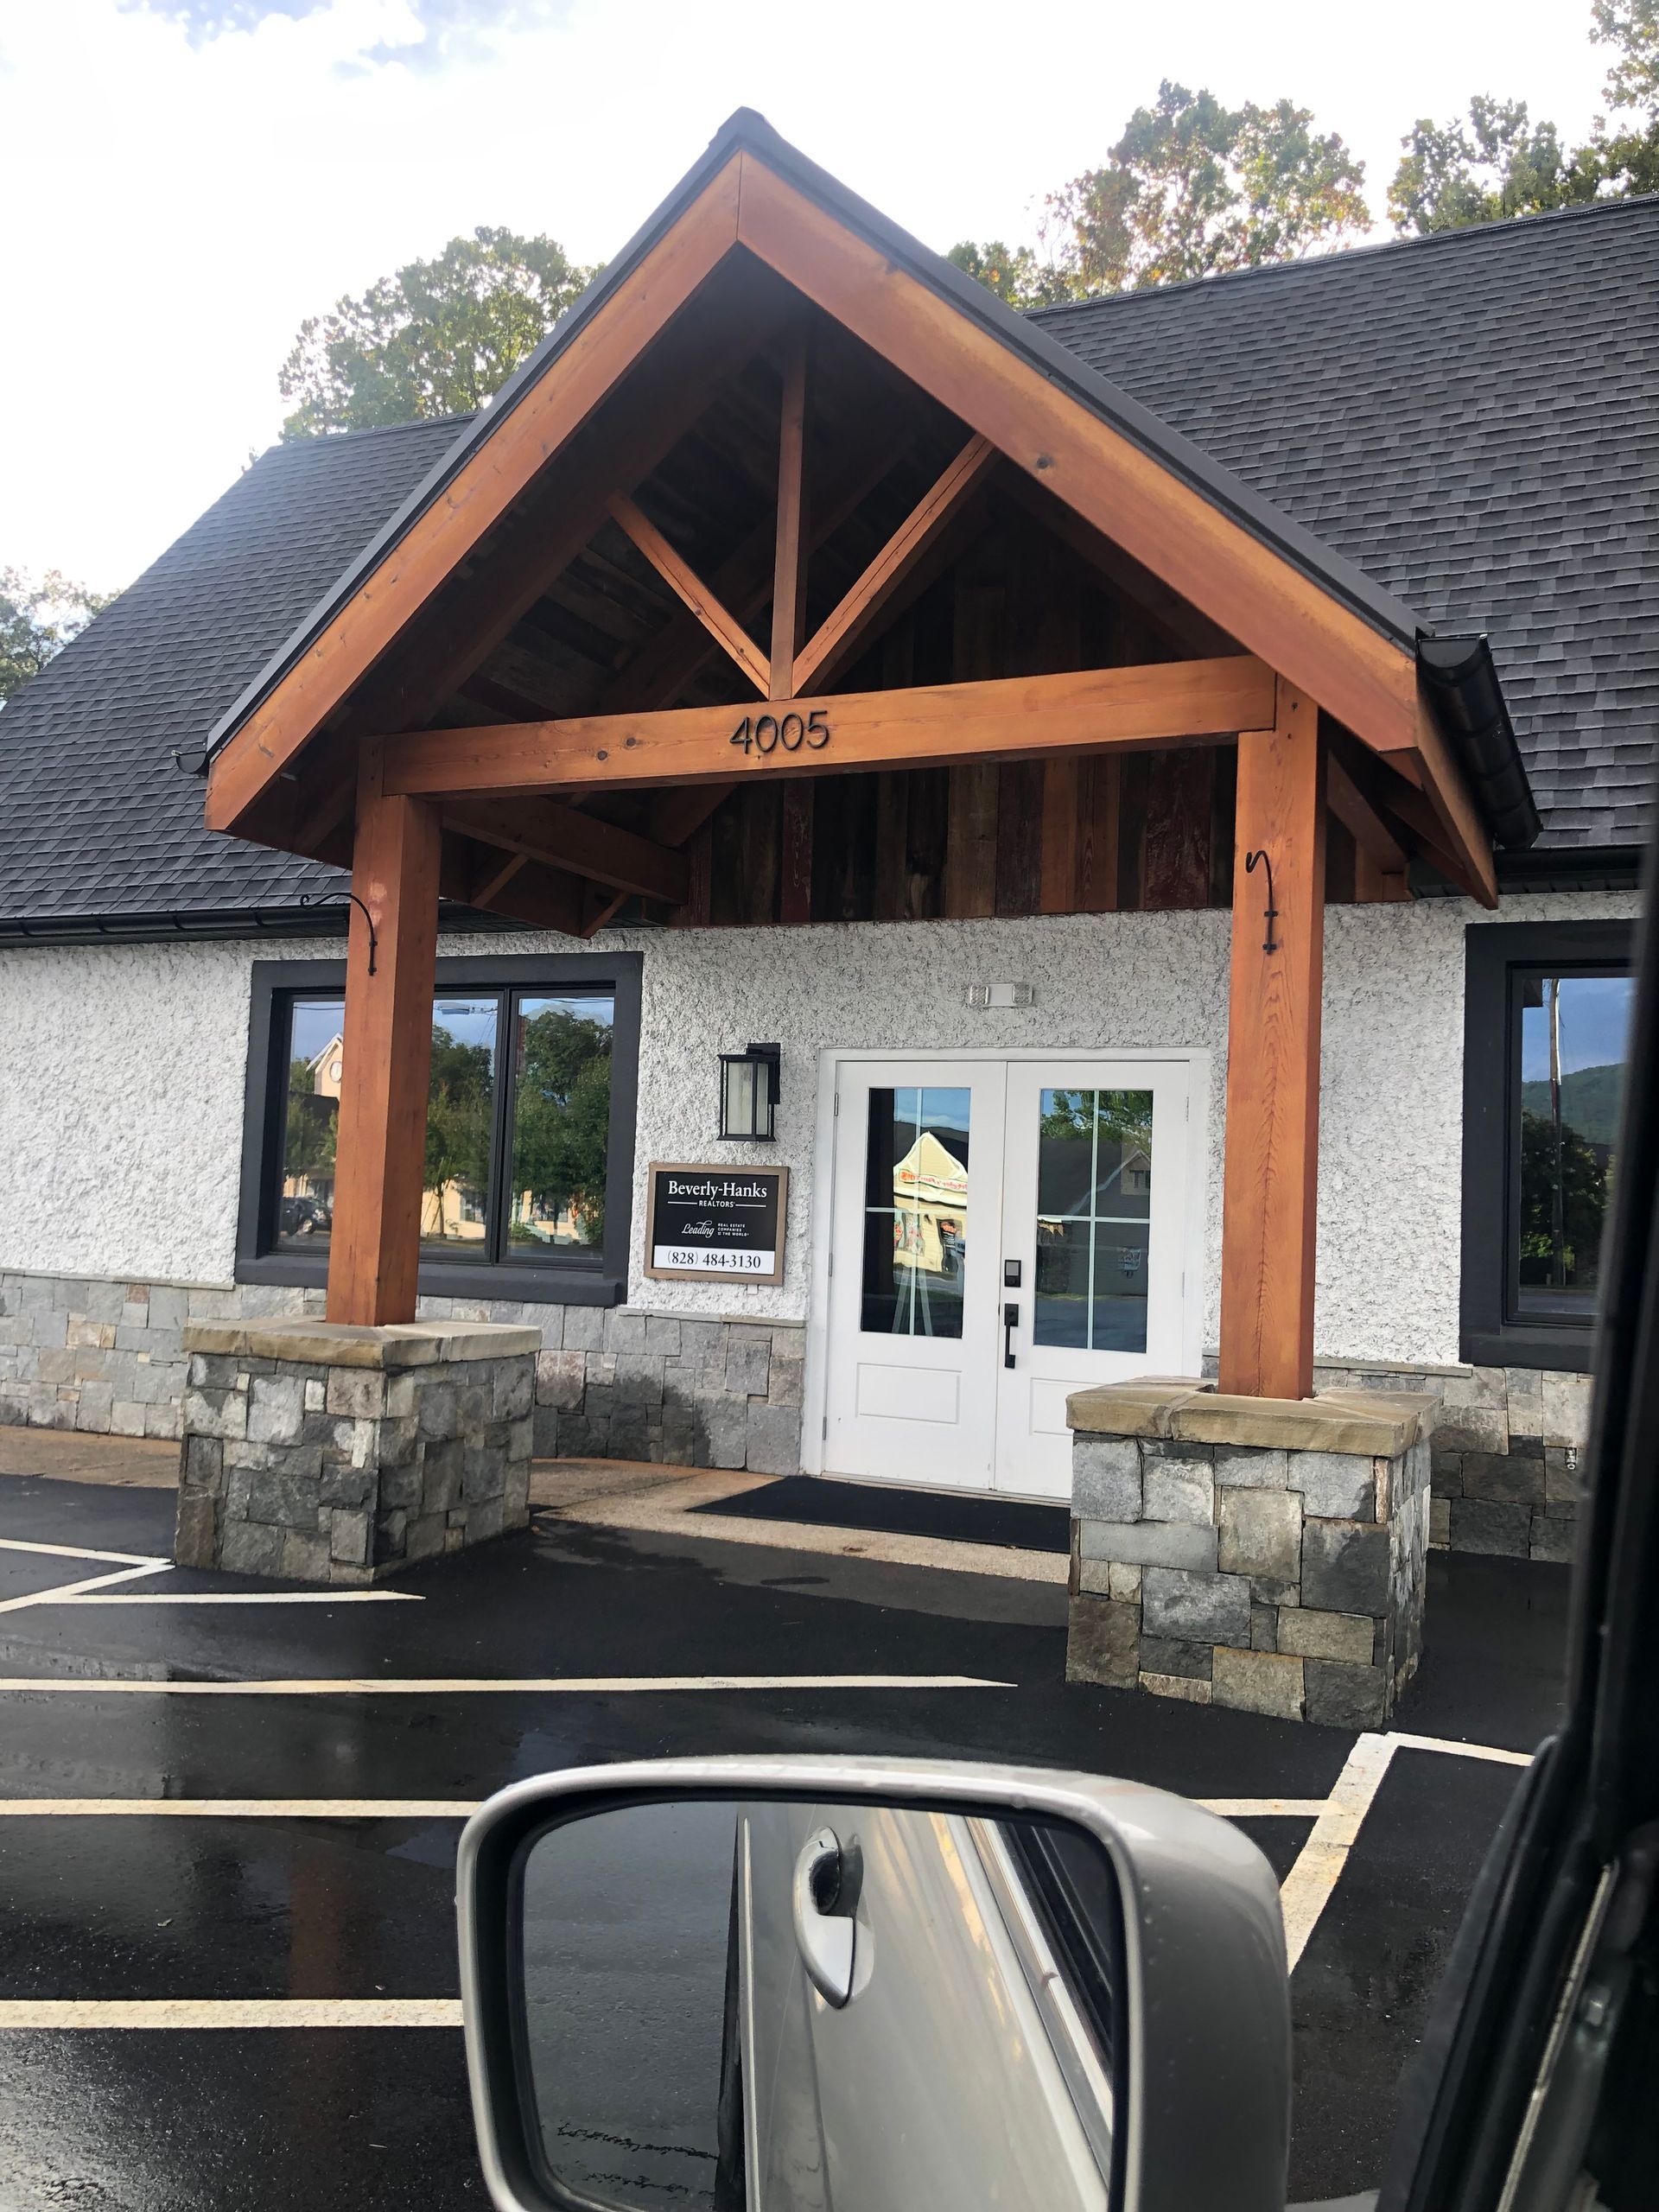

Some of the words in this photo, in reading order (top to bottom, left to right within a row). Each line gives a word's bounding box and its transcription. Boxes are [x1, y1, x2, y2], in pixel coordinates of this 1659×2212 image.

[729, 710, 829, 754] 4005
[668, 1180, 767, 1200] Beverly-Hanks
[681, 1220, 715, 1238] Leading
[668, 1250, 698, 1265] (828)
[702, 1253, 761, 1268] 484-3130
